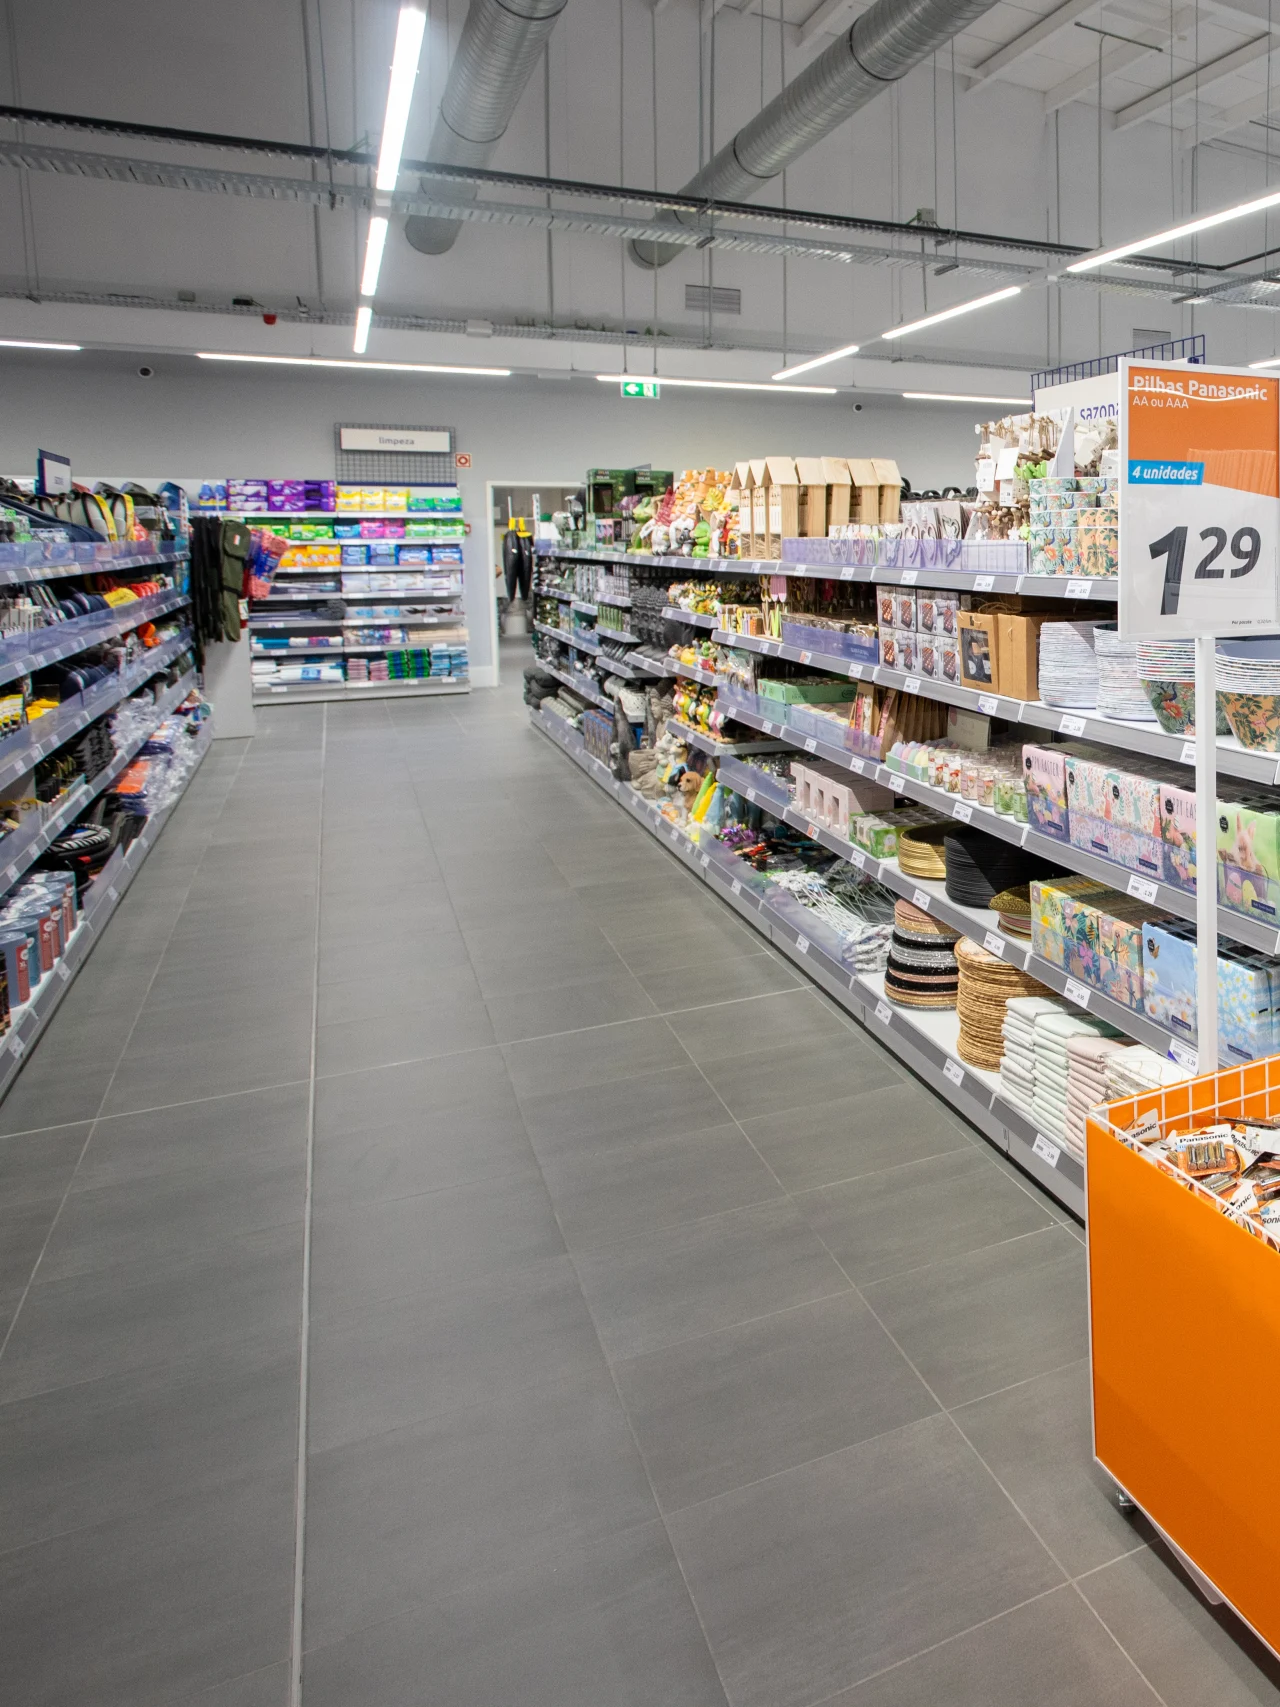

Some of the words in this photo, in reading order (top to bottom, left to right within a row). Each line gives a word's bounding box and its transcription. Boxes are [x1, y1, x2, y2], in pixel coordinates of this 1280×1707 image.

[1133, 375, 1184, 395] Pilhas
[1188, 380, 1268, 402] Panasonic
[1132, 396, 1148, 407] AA
[1151, 398, 1164, 408] ou
[1166, 397, 1189, 409] AAA
[1080, 404, 1118, 420] sazon
[379, 437, 415, 446] limpeza
[1132, 465, 1140, 479] 4
[1143, 464, 1198, 480] unidades
[1042, 760, 1061, 778] EASTER
[1179, 1133, 1229, 1144] Panasonic
